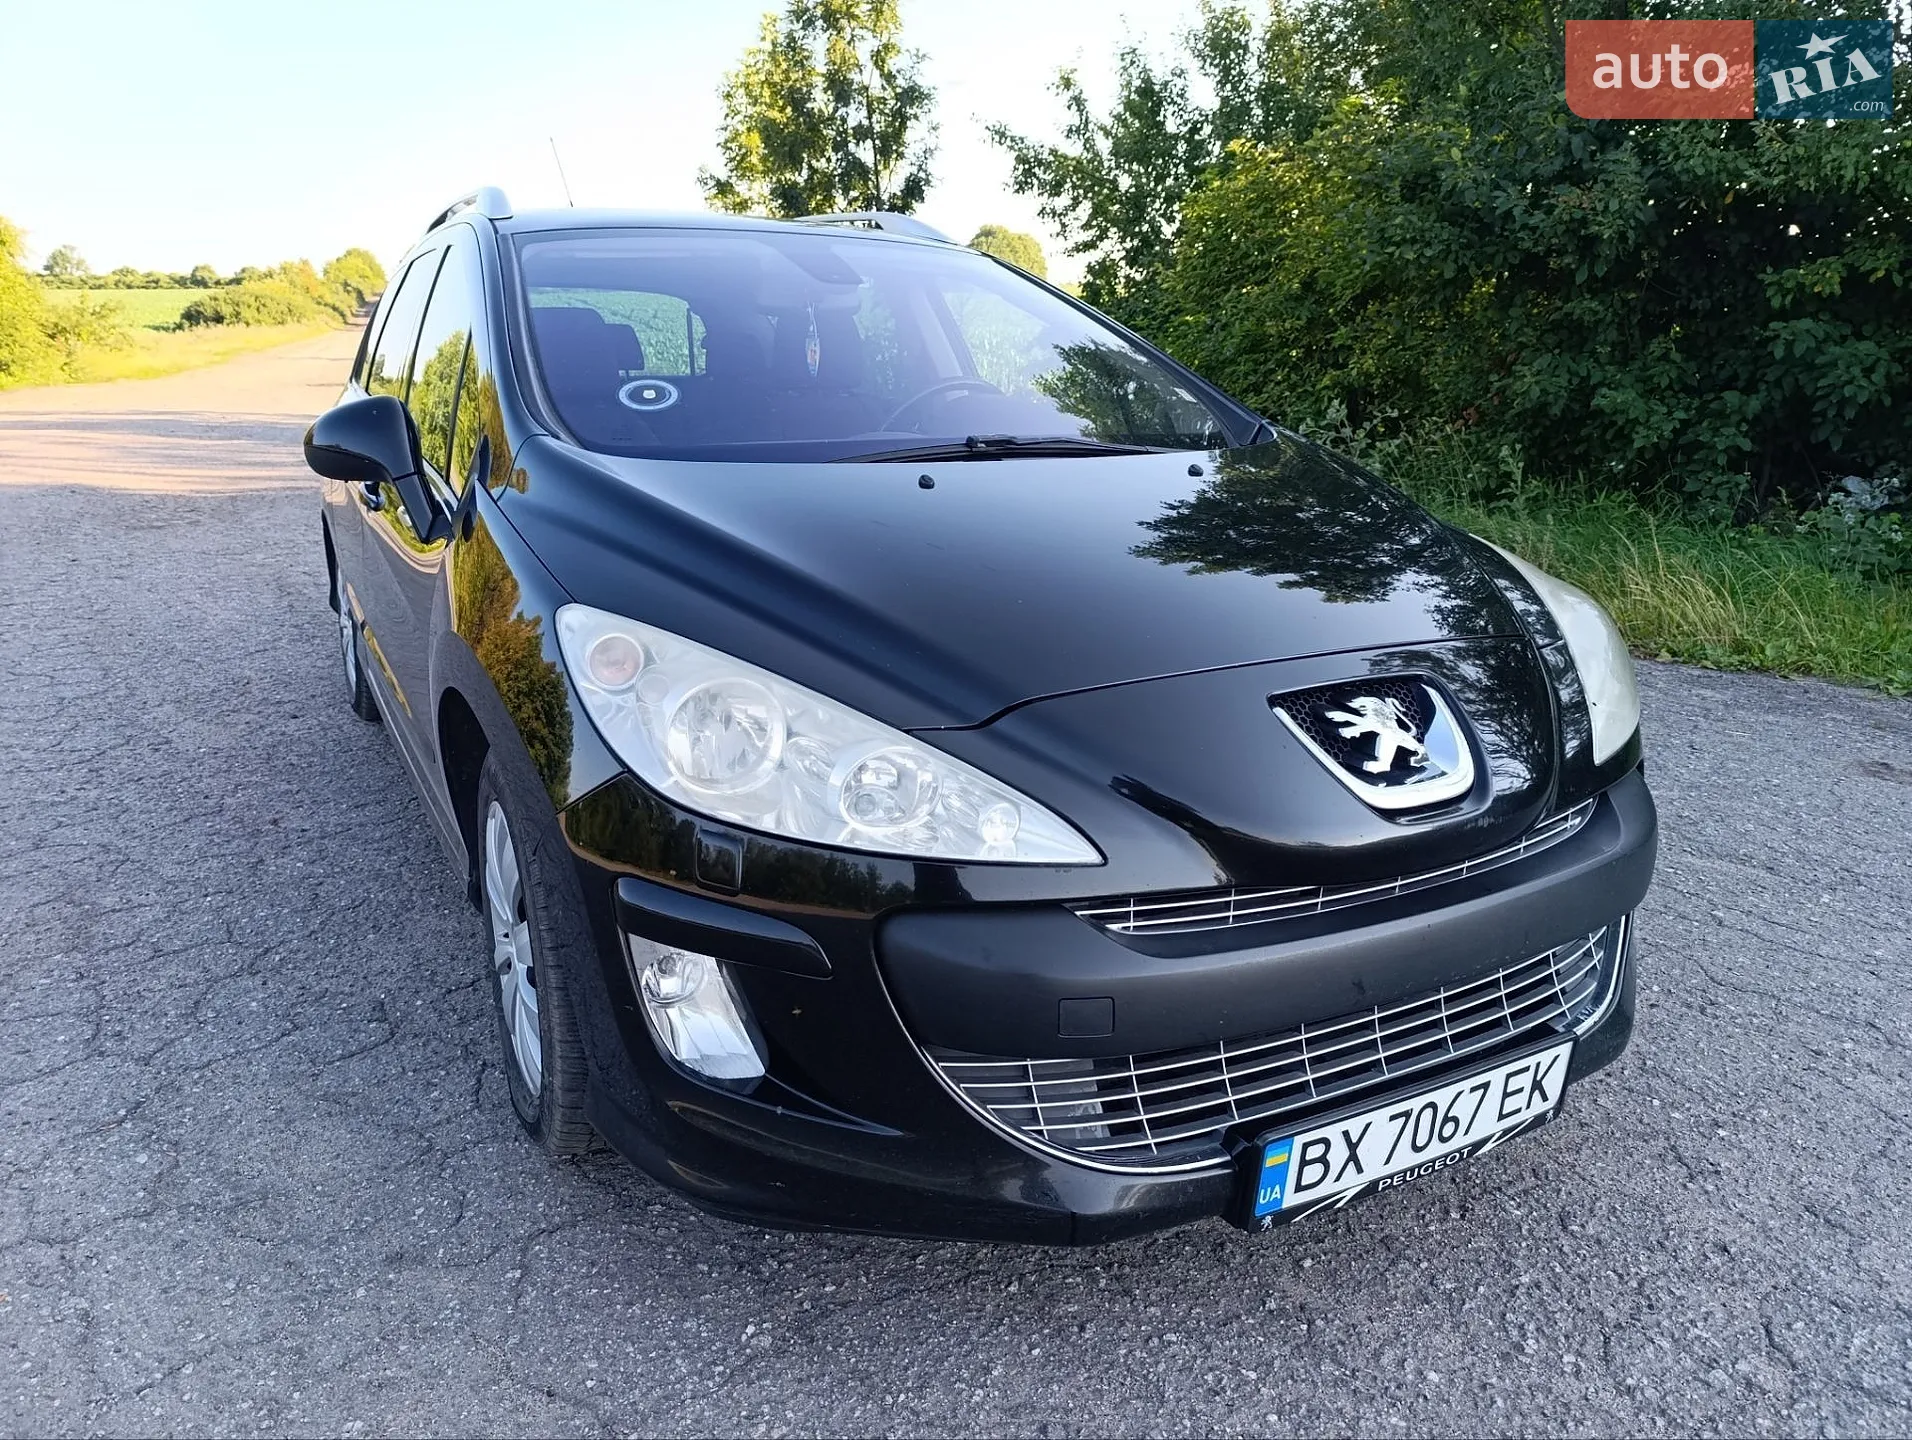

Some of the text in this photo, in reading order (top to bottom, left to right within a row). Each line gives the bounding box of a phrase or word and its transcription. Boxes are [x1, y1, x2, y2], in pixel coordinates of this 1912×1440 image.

[1293, 1053, 1561, 1194] BX 7067 EK
[1378, 1146, 1472, 1192] PEUGEOT
[1258, 1185, 1282, 1205] UA
